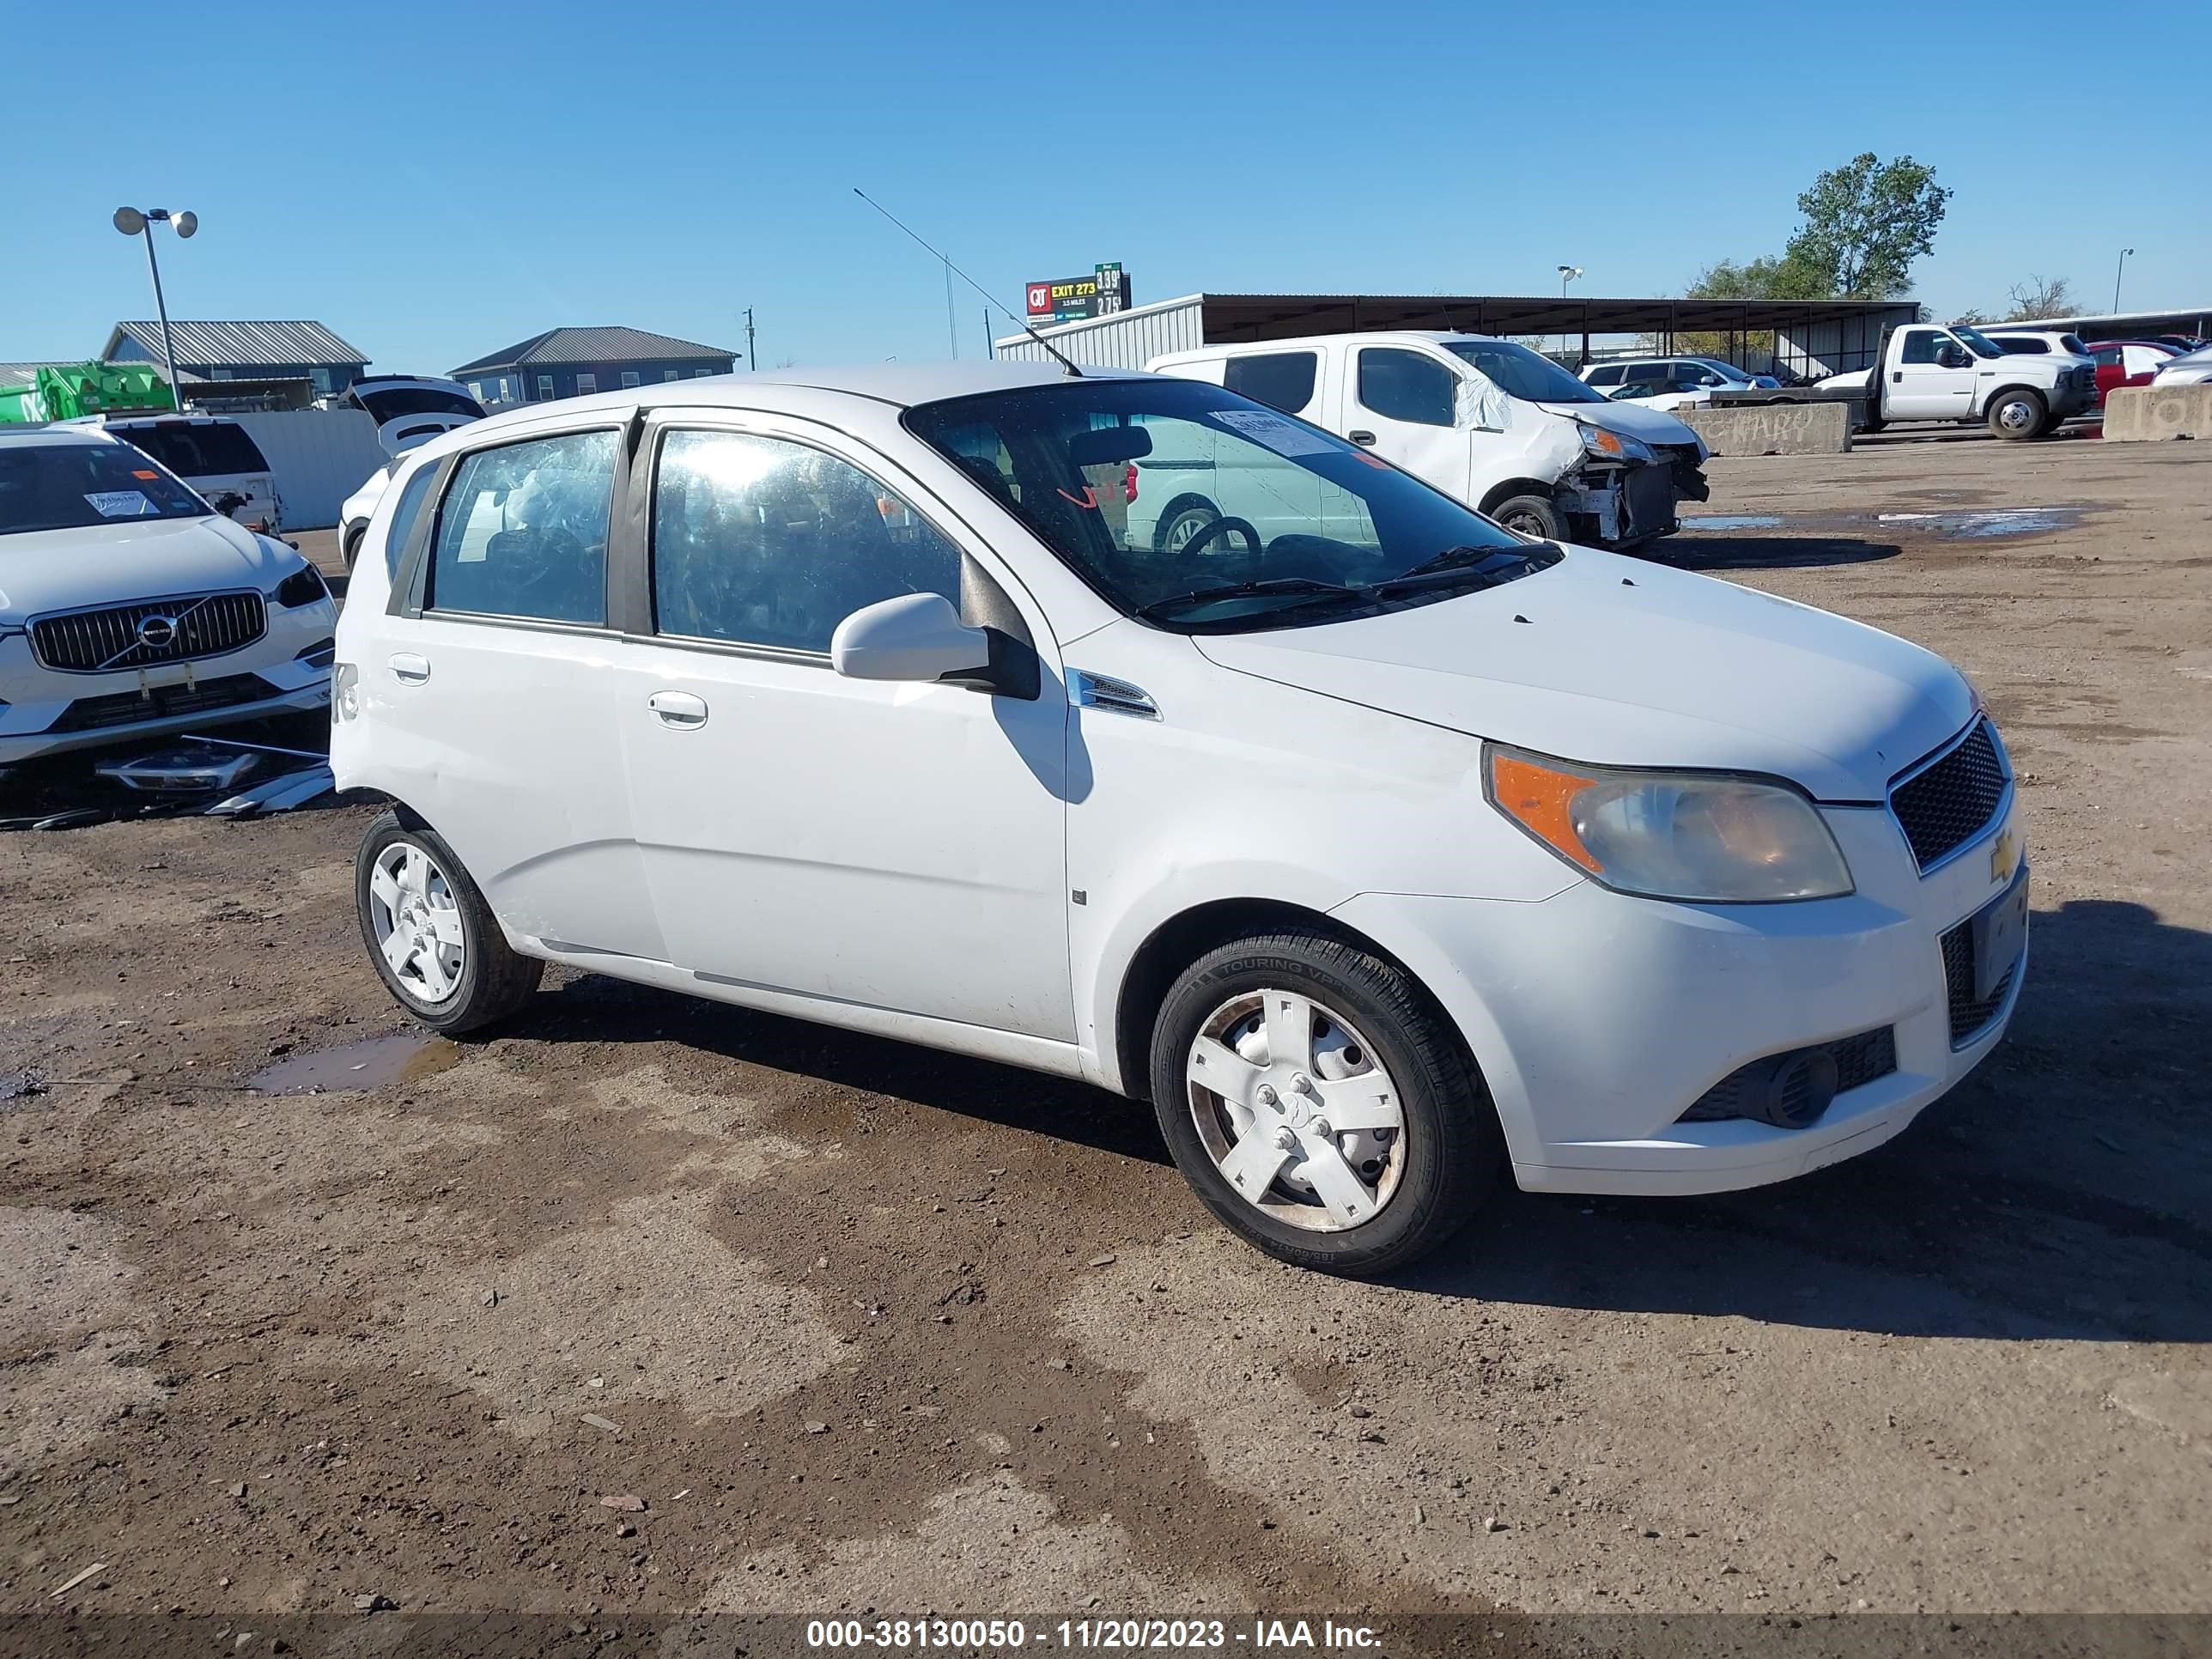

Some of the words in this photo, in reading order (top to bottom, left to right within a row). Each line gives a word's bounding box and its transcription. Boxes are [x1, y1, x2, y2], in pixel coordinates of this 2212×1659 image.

[1030, 289, 1047, 307] QT
[1052, 284, 1075, 298] EXIT
[1076, 283, 1096, 295] 273
[1070, 298, 1086, 307] MILES
[1222, 957, 1304, 975] TOURING
